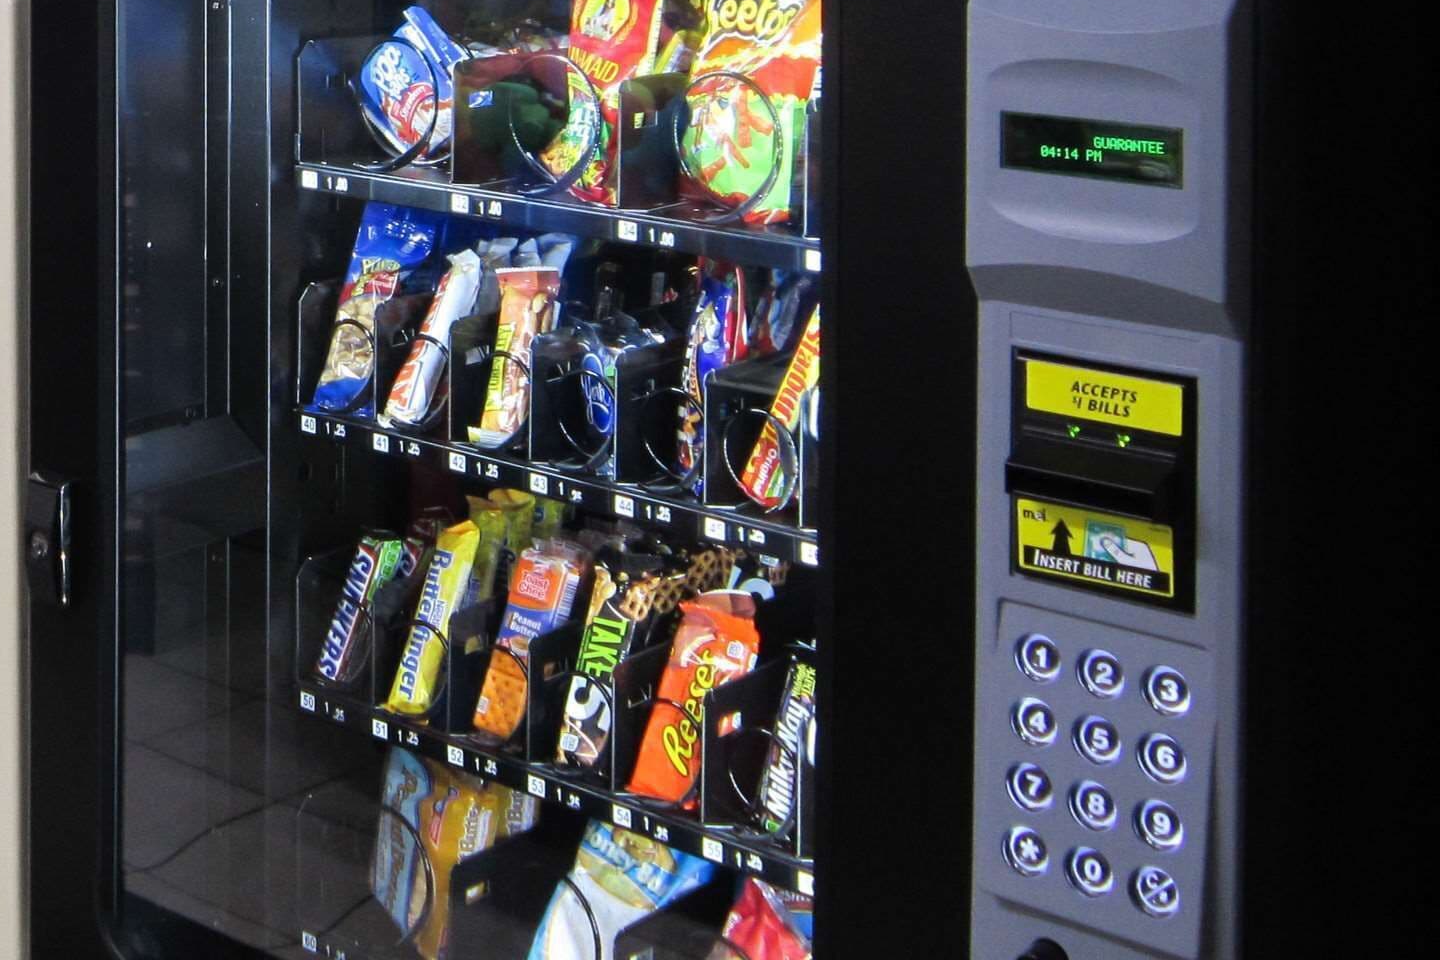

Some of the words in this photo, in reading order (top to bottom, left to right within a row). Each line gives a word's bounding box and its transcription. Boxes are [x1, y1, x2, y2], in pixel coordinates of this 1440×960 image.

[1040, 145, 1079, 160] 04:14
[1086, 149, 1103, 163] PM
[1093, 136, 1165, 155] GUARANTEE
[1070, 381, 1138, 404] ACCEPTS
[1087, 398, 1131, 418] BILLS
[303, 417, 315, 431] 40
[375, 436, 387, 450] 41
[451, 455, 465, 470] 42
[1034, 549, 1081, 574] INSERT
[1083, 561, 1112, 581] BILL
[1116, 568, 1153, 589] HERE
[582, 617, 629, 678] TAKE
[1036, 647, 1047, 668] 1
[1094, 662, 1114, 685] 2
[1160, 678, 1179, 703] 3
[303, 696, 315, 710] 50
[375, 722, 387, 736] 51
[1029, 711, 1047, 733] 4
[1092, 728, 1109, 750] 5
[450, 749, 463, 763] 52
[1157, 745, 1177, 769] 6
[531, 779, 545, 794] 53
[1025, 773, 1043, 796] 7
[1088, 793, 1106, 815] 8
[616, 809, 630, 821] 54
[1152, 810, 1171, 835] 9
[707, 842, 721, 855] 55
[1084, 859, 1101, 882] 0
